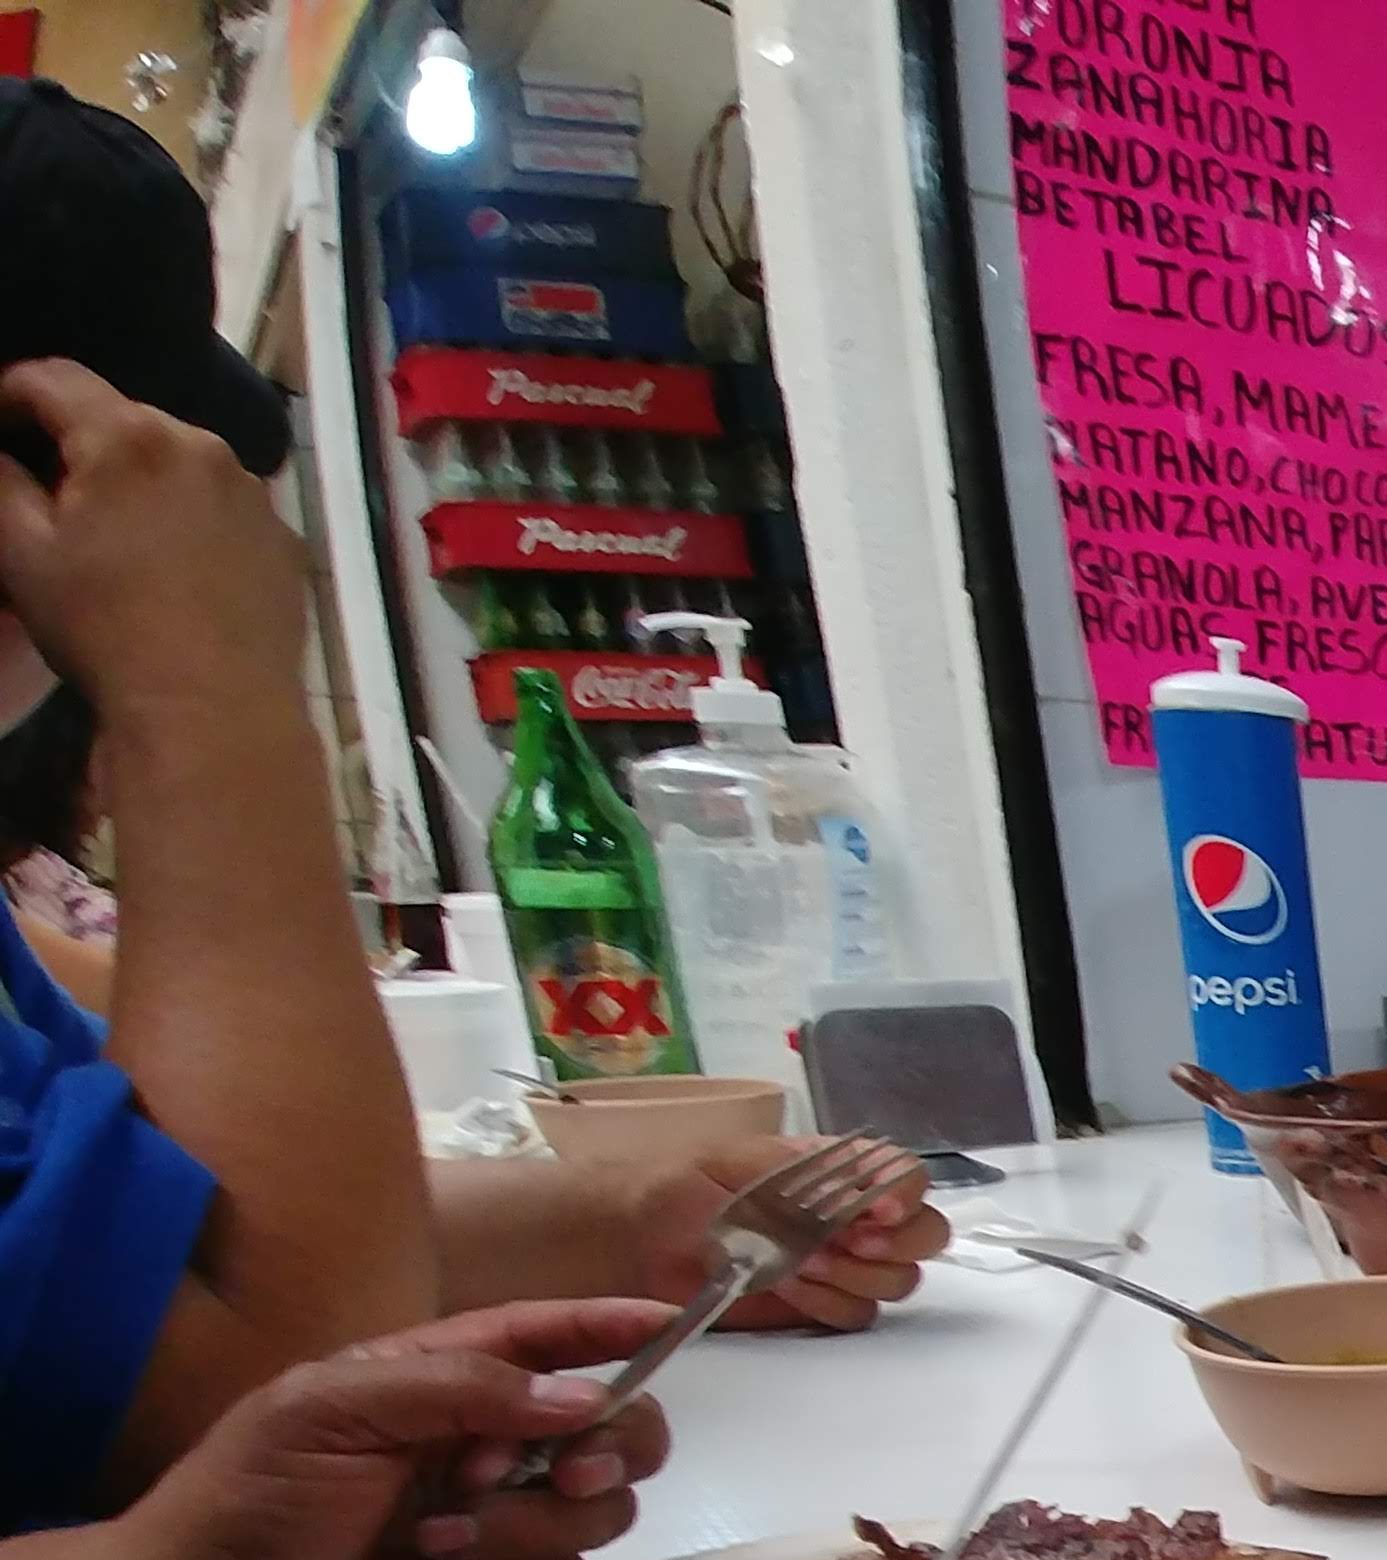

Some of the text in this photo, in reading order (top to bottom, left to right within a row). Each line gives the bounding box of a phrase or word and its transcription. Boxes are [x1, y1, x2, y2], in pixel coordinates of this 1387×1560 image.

[1022, 0, 1294, 107] ORONJA
[1006, 38, 1333, 178] ZANAHORIA
[1010, 111, 1334, 237] MANDARINA
[1015, 168, 1248, 263] BETABEL
[1187, 968, 1301, 1015] pepsi
